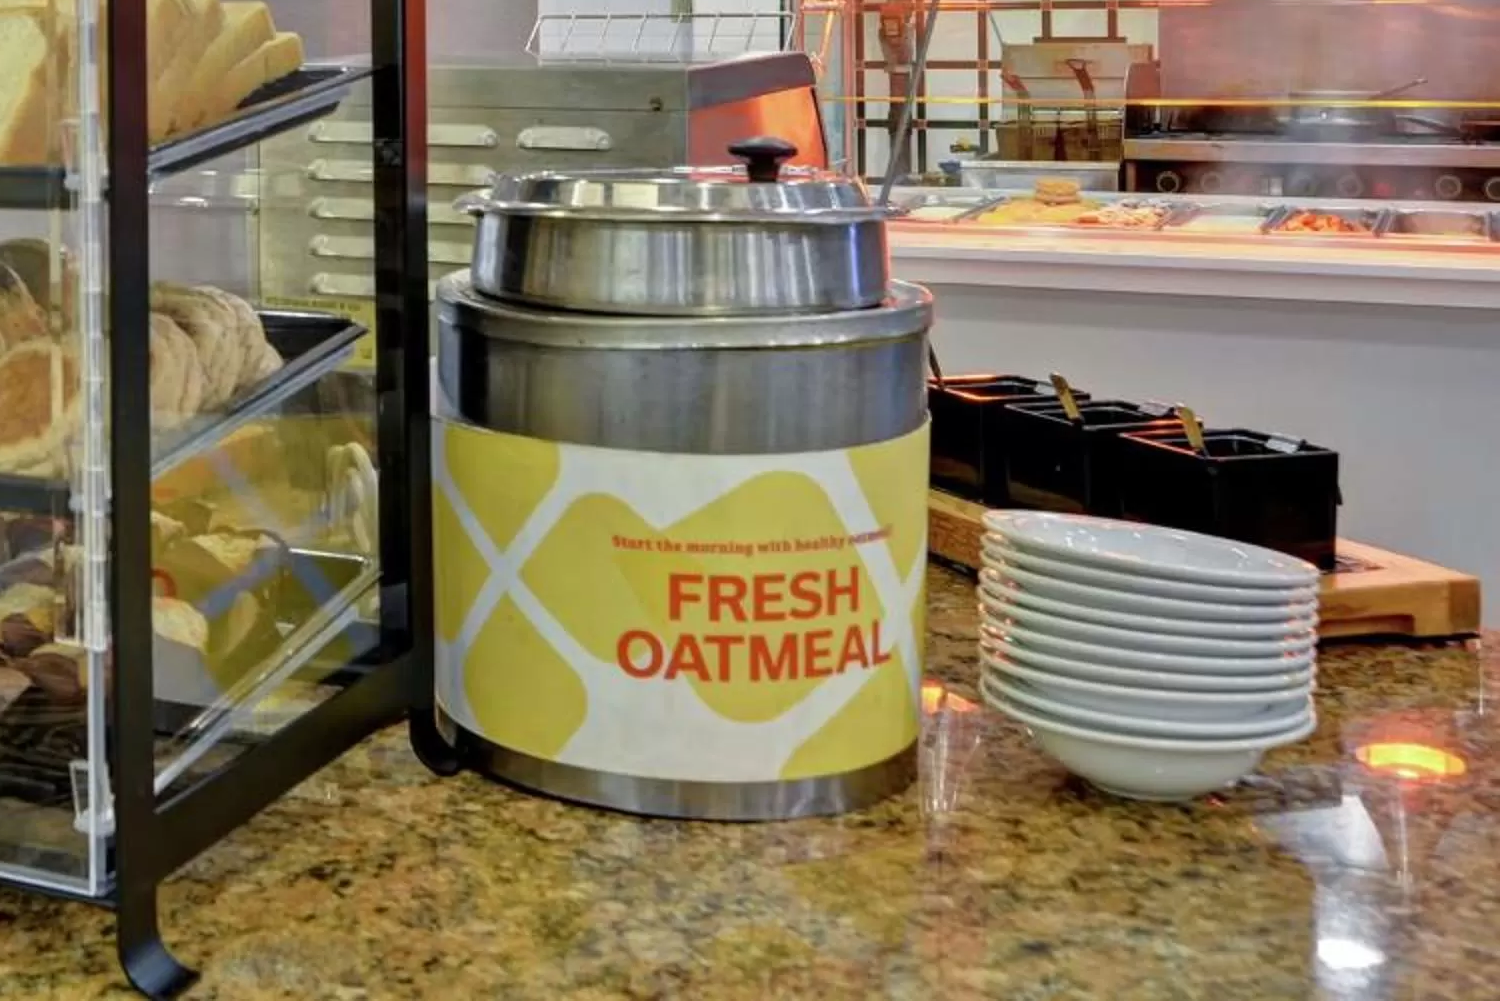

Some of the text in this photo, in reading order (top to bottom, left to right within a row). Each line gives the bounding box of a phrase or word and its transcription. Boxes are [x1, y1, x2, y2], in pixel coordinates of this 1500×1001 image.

[611, 534, 653, 552] Start
[655, 537, 682, 552] the
[686, 540, 754, 558] morning
[756, 539, 793, 553] with
[795, 534, 846, 553] healthy
[667, 565, 860, 623] FRESH
[615, 618, 892, 683] OATMEAL
